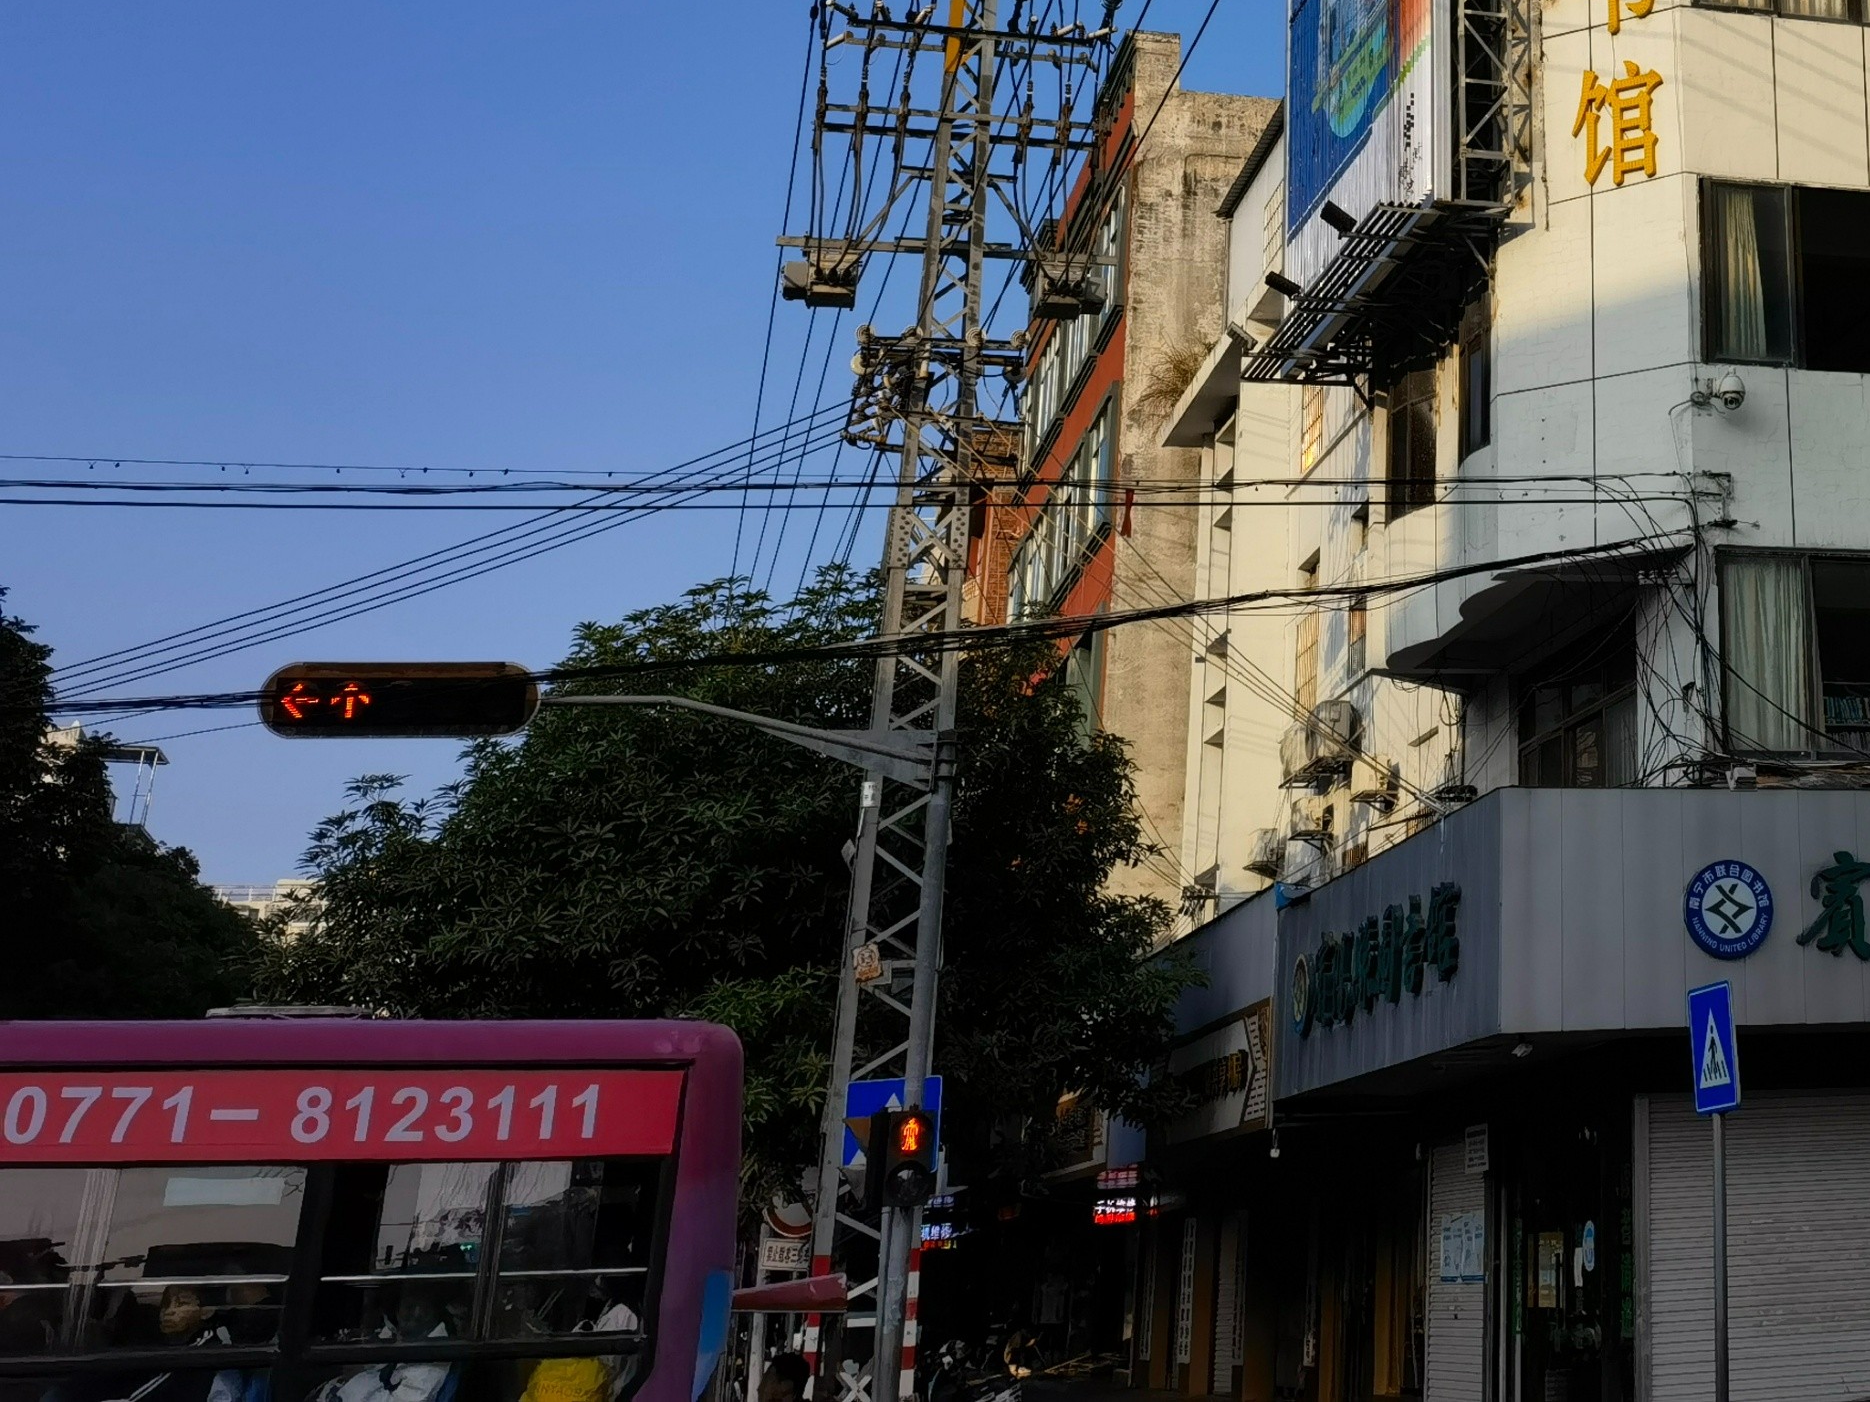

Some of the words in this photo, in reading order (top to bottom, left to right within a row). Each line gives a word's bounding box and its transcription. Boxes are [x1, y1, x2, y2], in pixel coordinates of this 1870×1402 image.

[1688, 863, 1770, 910] 南宁市联合图书馆
[1691, 916, 1718, 949] NANNING
[1719, 940, 1747, 952] UNITED
[1747, 912, 1769, 946] LIBRARY
